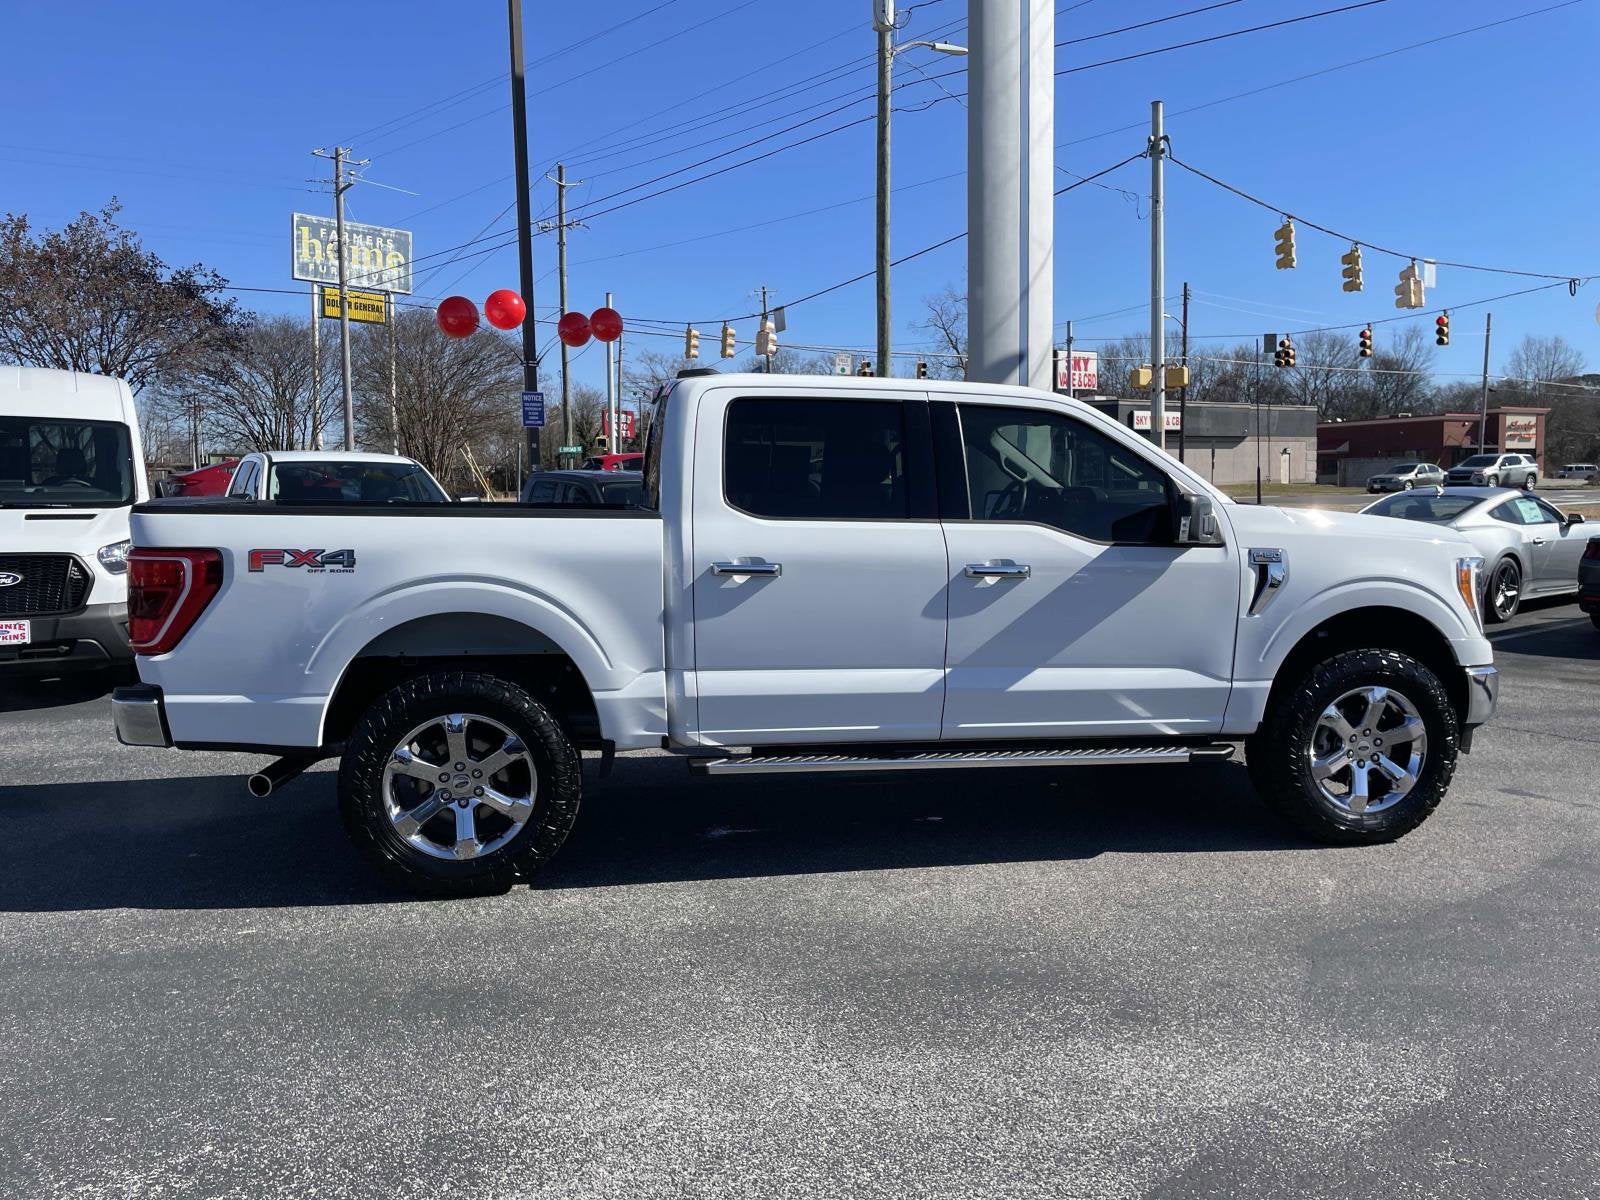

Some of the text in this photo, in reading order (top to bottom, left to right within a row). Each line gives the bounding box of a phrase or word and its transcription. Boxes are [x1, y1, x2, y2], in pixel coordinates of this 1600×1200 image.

[320, 228, 393, 249] FARMERS
[299, 226, 405, 272] home
[326, 298, 384, 313] DOLR GENERAL
[1058, 371, 1096, 388] VAE & CBD
[523, 394, 543, 402] NOTICE
[1135, 415, 1148, 426] SKY
[1165, 416, 1171, 426] &
[1171, 416, 1182, 426] CB
[248, 549, 356, 573] FX4
